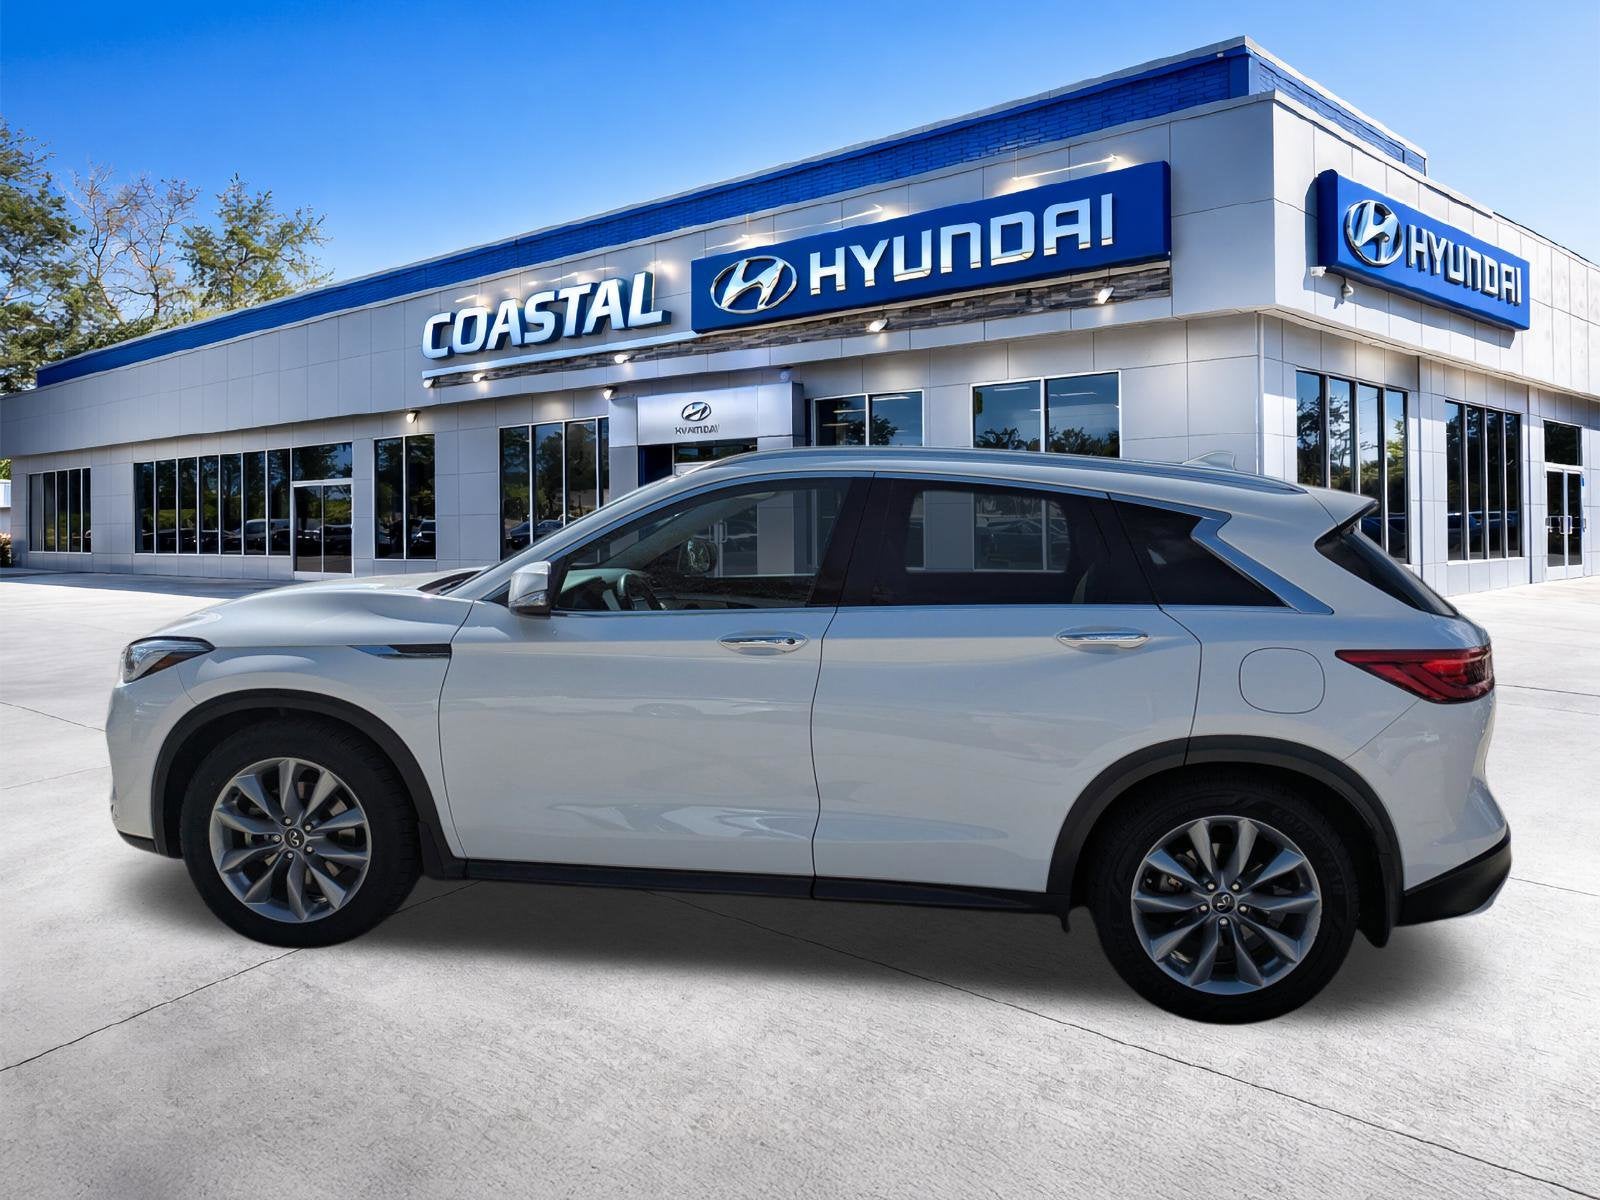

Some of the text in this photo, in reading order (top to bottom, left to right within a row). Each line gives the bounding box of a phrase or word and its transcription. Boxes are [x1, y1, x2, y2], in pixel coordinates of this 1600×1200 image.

[809, 193, 1114, 296] HYUNDAI
[1406, 224, 1522, 306] HYUNDAI
[422, 271, 671, 359] COASTAL
